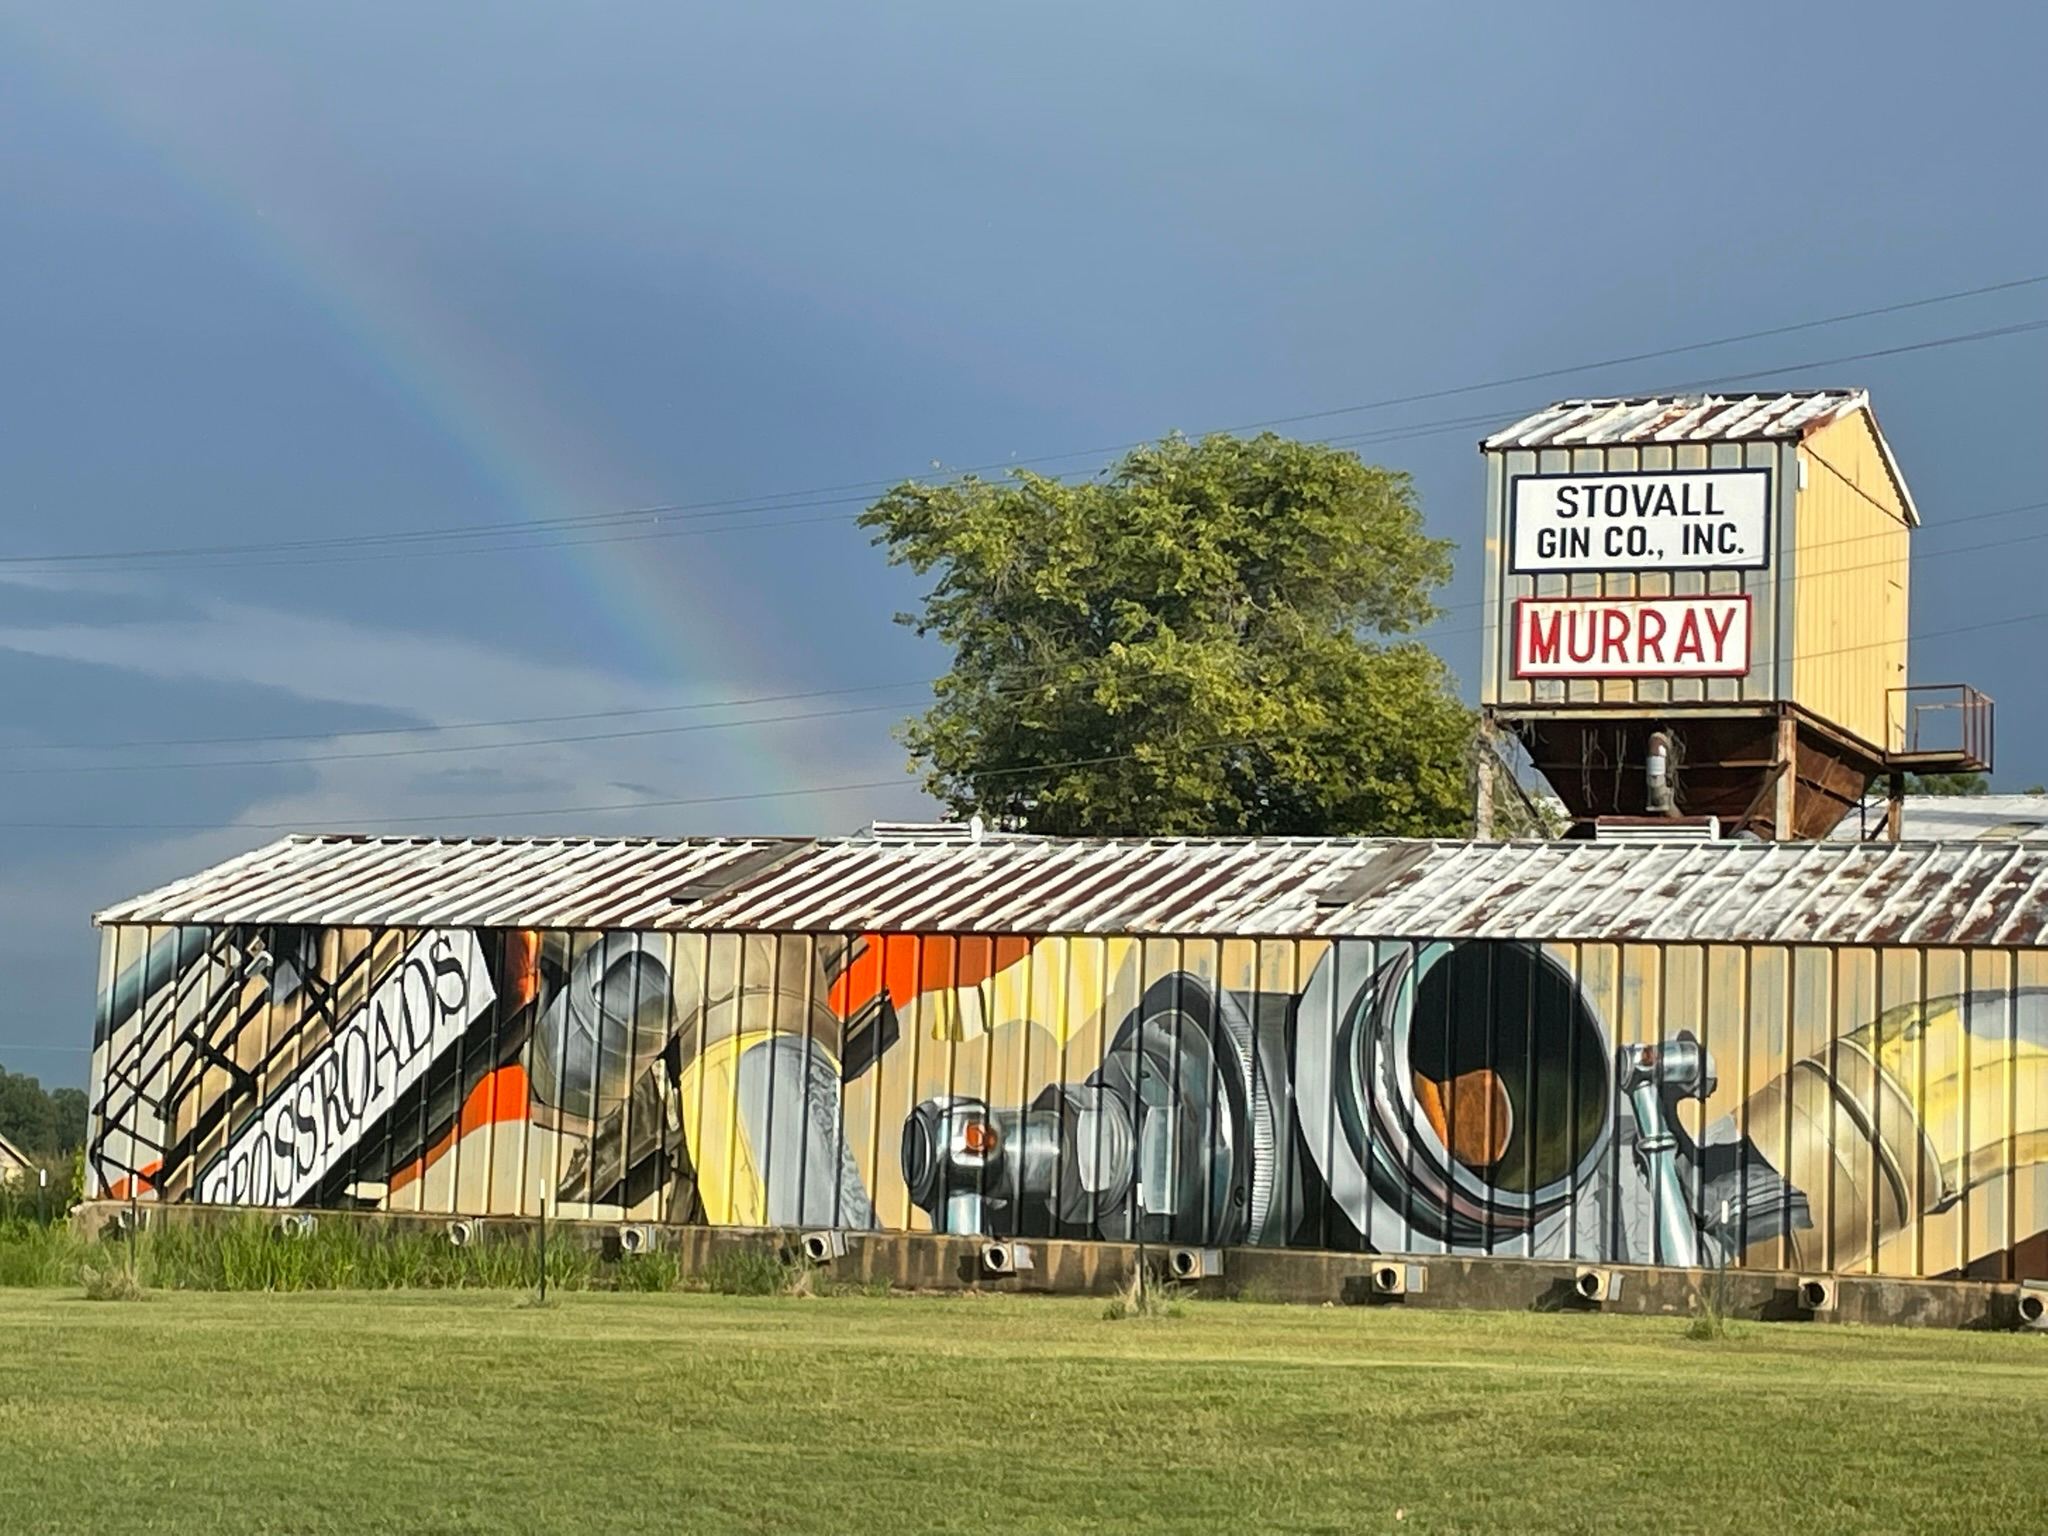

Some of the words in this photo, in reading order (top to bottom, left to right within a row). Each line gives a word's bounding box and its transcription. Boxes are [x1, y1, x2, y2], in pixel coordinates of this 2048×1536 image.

[1556, 483, 1725, 519] STOVALL
[1537, 527, 1590, 558] GIN
[1604, 526, 1664, 560] CO.,
[1683, 523, 1745, 555] INC.
[1529, 608, 1737, 664] MURRAY
